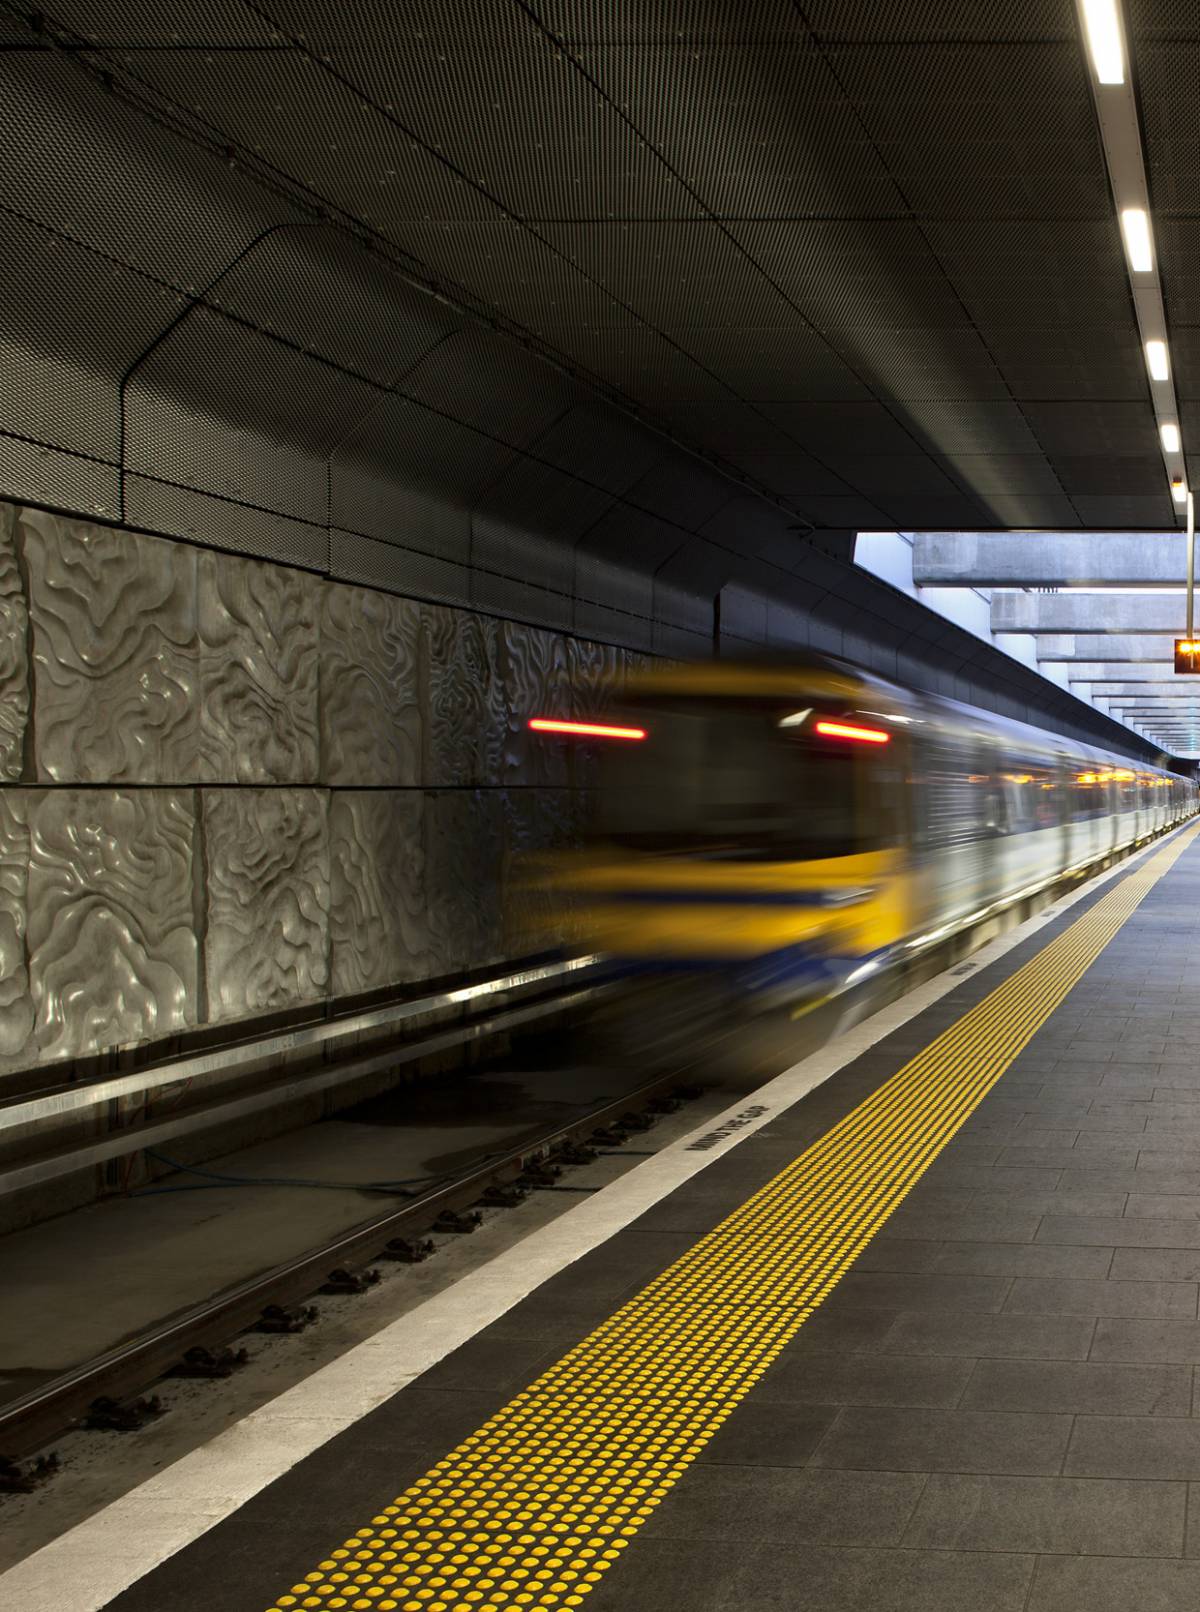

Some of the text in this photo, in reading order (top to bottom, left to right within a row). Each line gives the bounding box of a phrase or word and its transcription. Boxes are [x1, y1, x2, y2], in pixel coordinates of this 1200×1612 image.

[684, 1105, 770, 1151] MIND THE GAP
